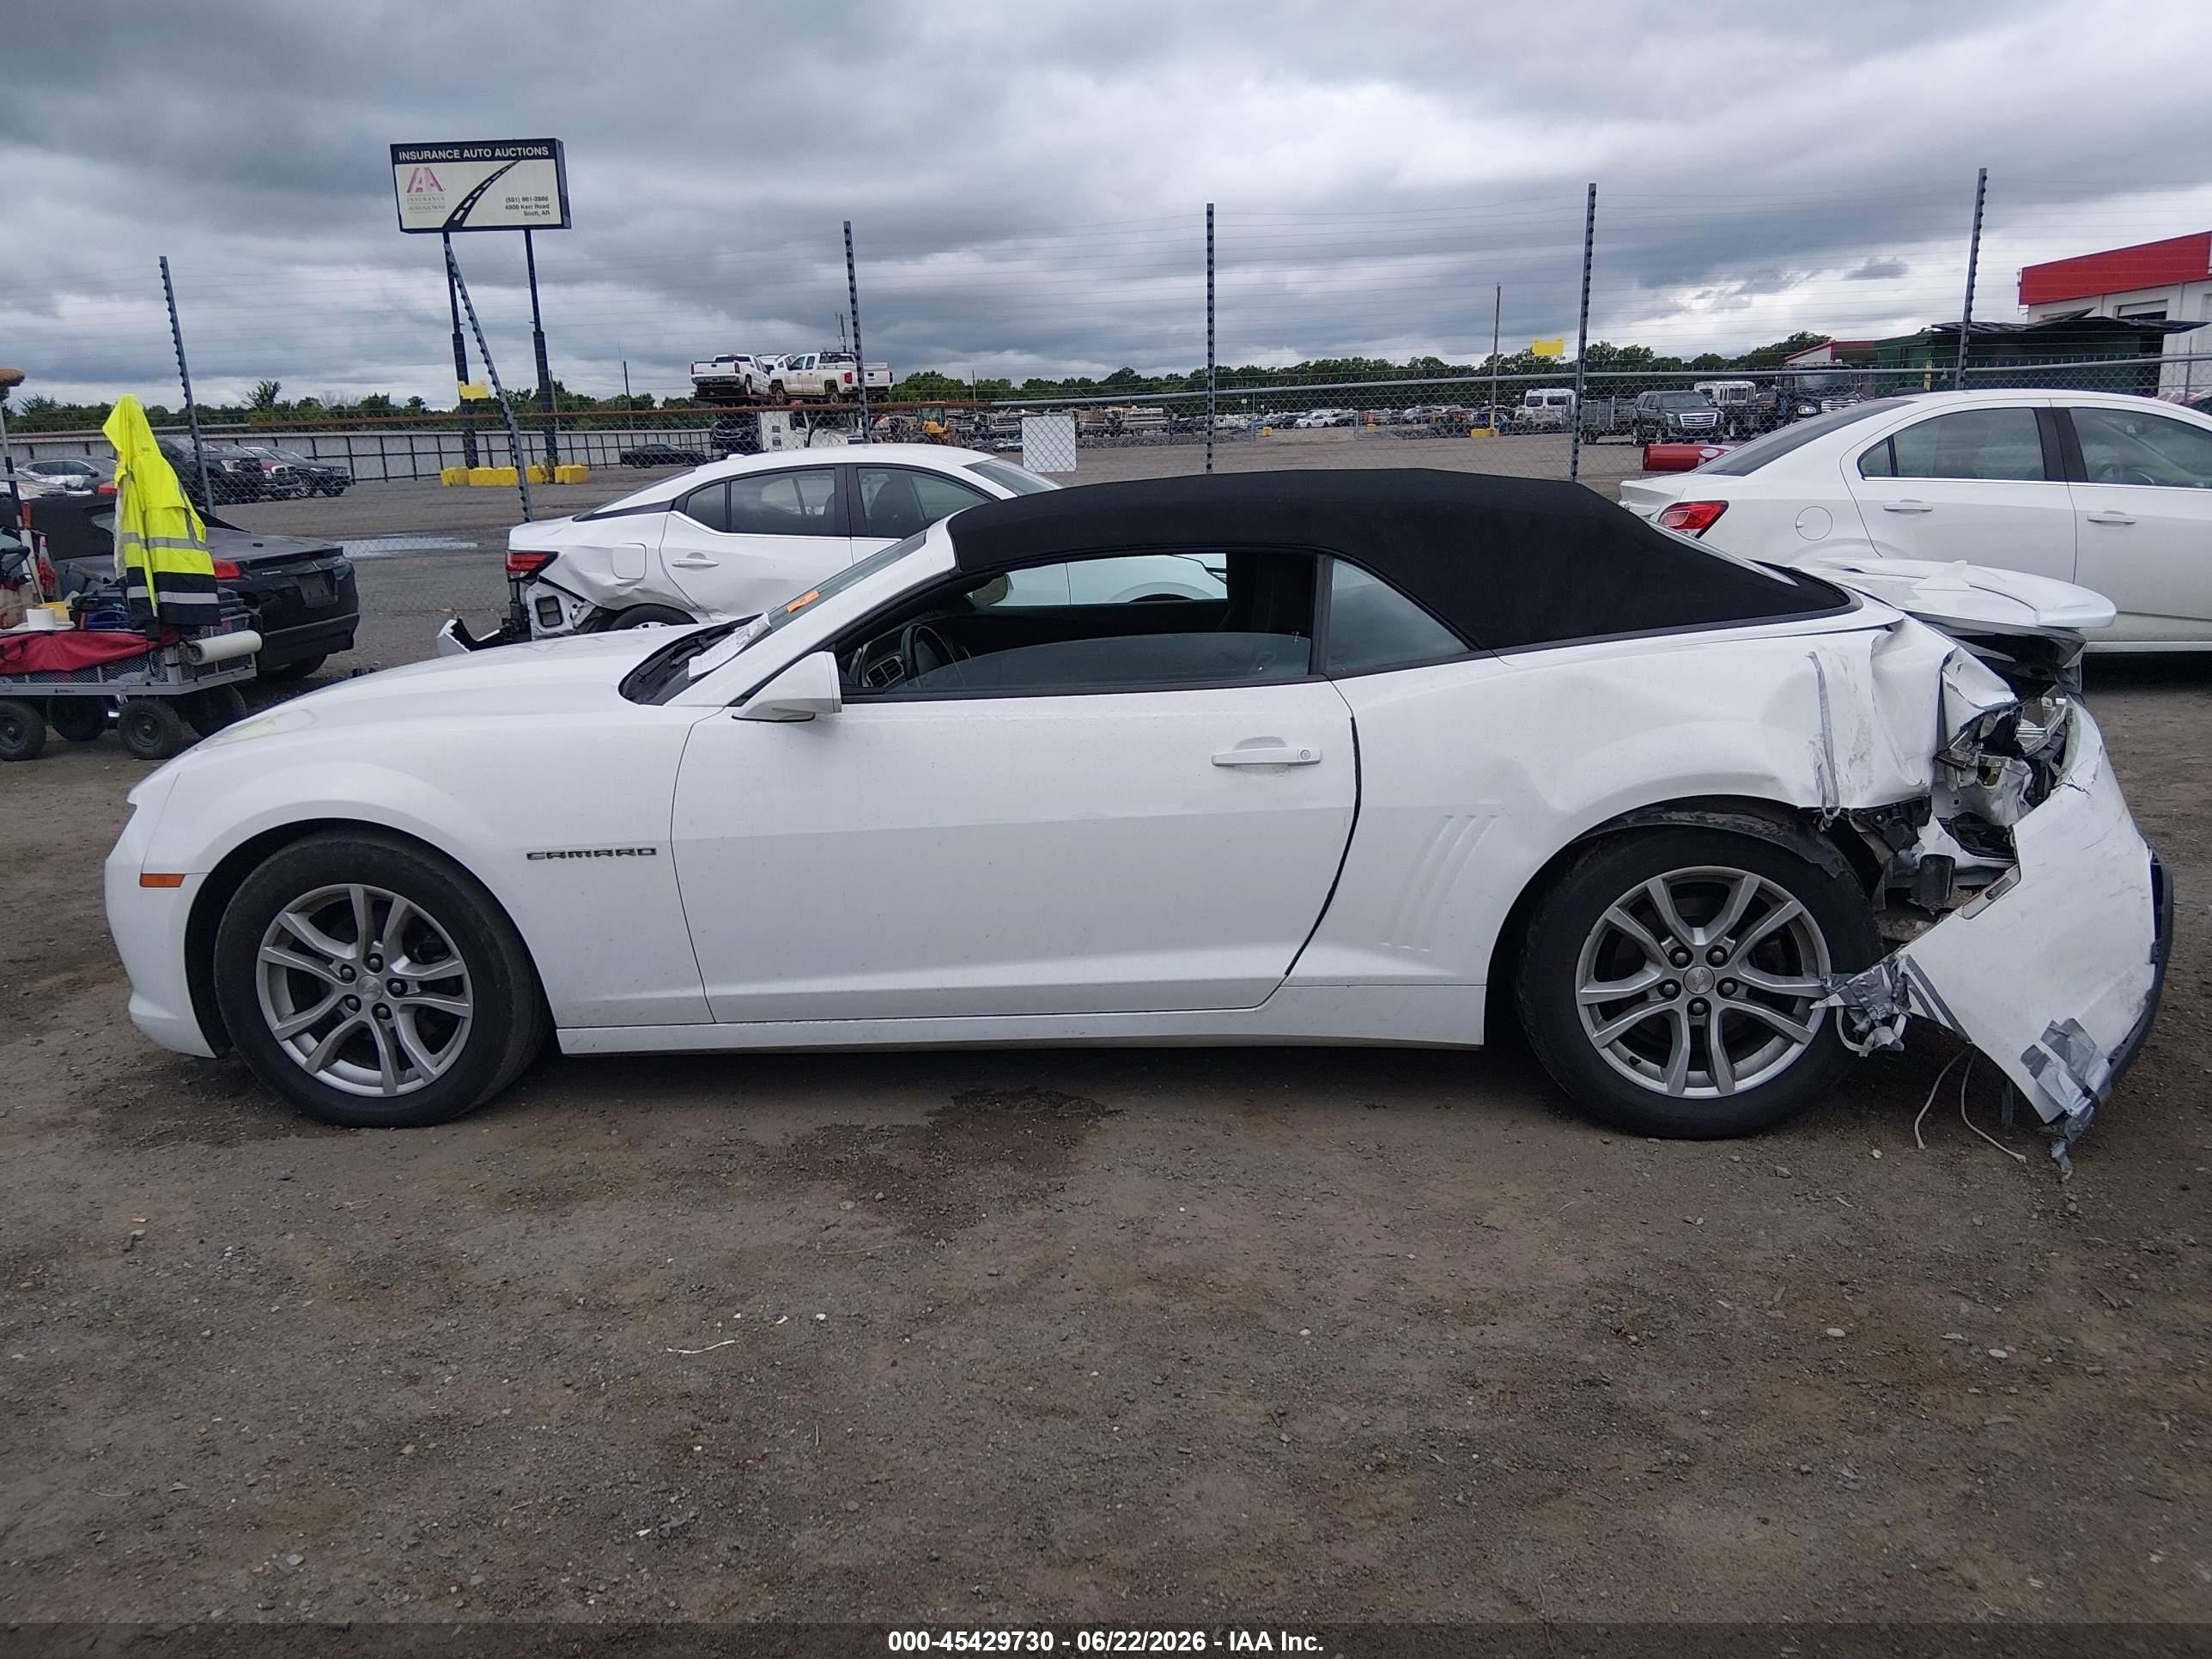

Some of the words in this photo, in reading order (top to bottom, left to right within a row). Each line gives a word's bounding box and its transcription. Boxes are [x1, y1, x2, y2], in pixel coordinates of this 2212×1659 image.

[398, 149, 461, 161] INSURANCE
[463, 148, 492, 158] AUTO
[494, 146, 550, 157] AUCTIONS
[526, 848, 657, 860] CAMARO
